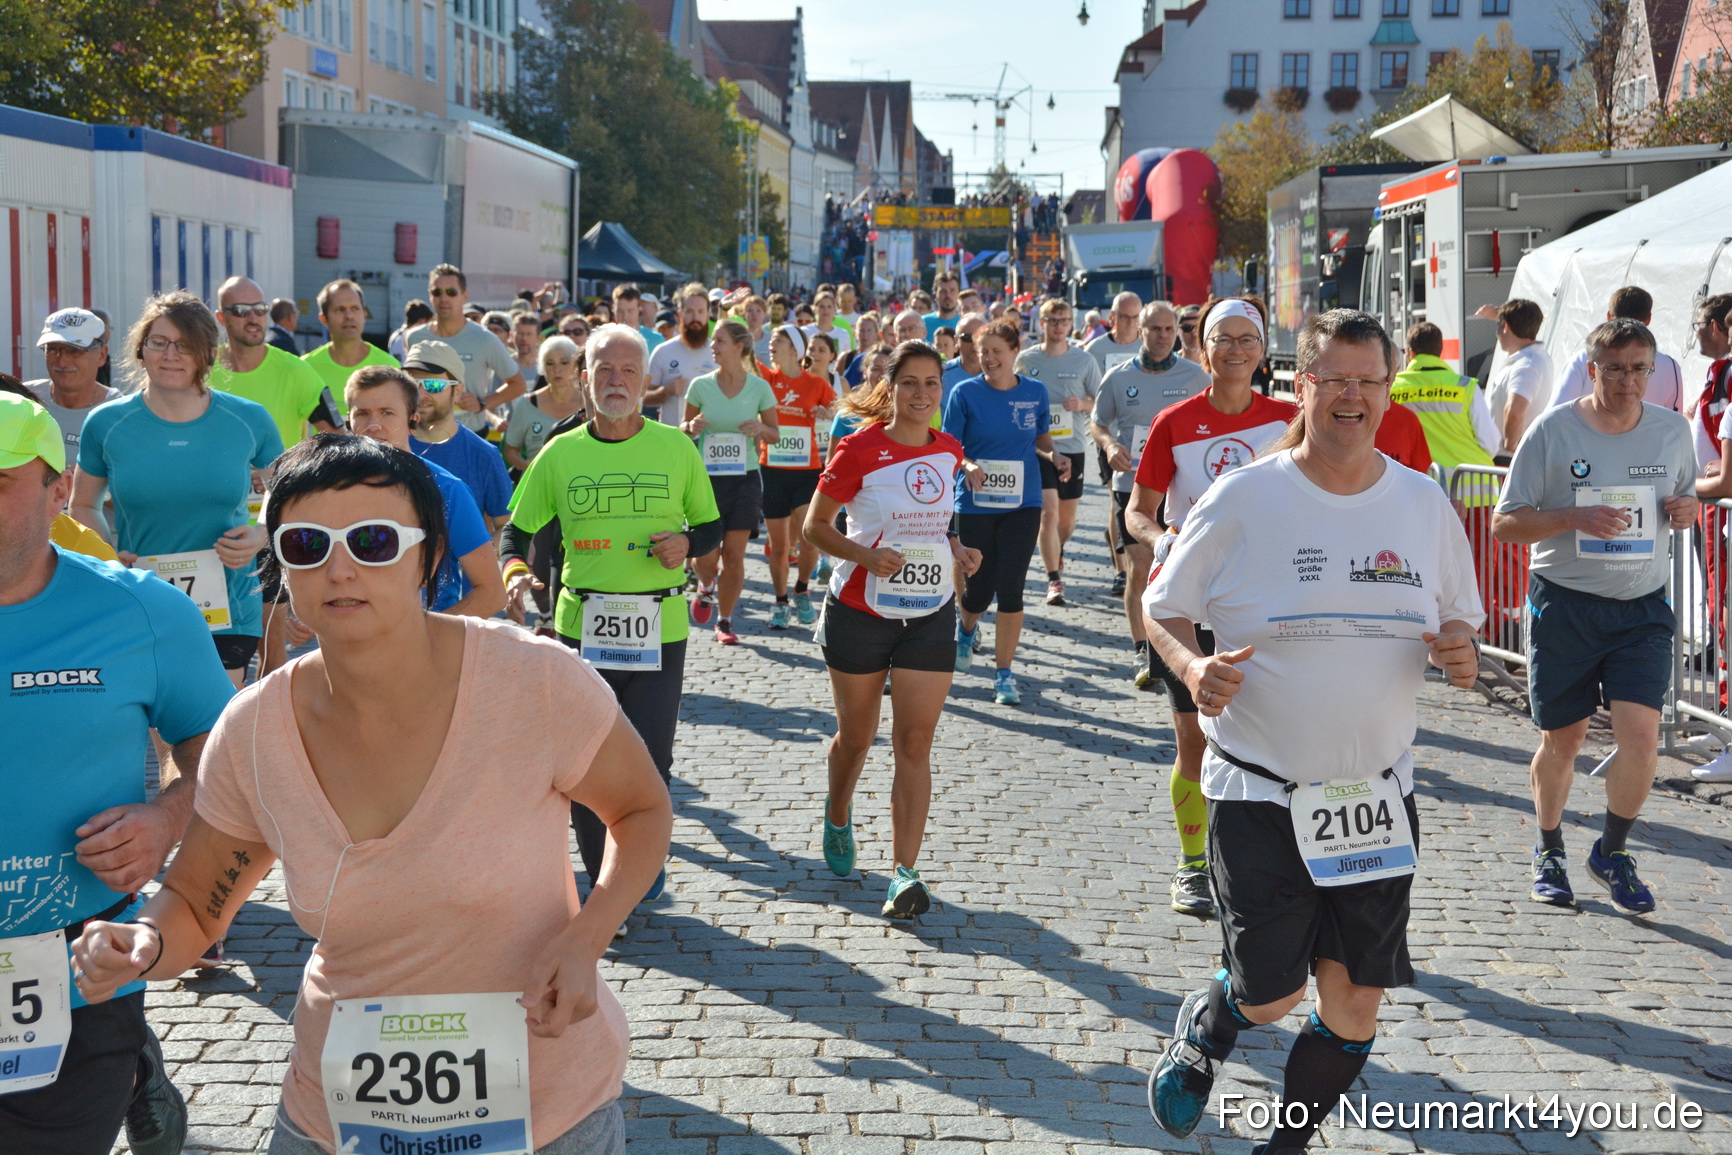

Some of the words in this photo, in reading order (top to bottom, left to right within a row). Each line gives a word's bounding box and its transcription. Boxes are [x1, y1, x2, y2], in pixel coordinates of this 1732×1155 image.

[919, 210, 966, 221] START
[709, 445, 740, 458] 3089
[1628, 465, 1667, 476] BOCK
[981, 473, 1016, 488] 2999
[1601, 493, 1636, 502] BOCK
[892, 511, 923, 520] LAUFEN
[573, 539, 611, 550] MERZ
[1604, 543, 1632, 552] Erwin
[901, 548, 934, 557] BOCK
[1297, 547, 1323, 555] Aktion
[159, 560, 198, 571] BOCK
[1293, 557, 1328, 565] Laufshirt
[1604, 561, 1645, 571] Stadtlauf
[888, 563, 942, 585] 2638
[1298, 566, 1323, 574] Größe
[1299, 574, 1321, 582] XXXL
[604, 601, 639, 610] BOCK
[899, 597, 929, 608] Sevinc
[1395, 608, 1426, 620] Schiller
[594, 614, 649, 639] 2510
[600, 650, 642, 662] Raimund
[11, 668, 105, 690] BOCK
[10, 689, 40, 697] inspired
[53, 686, 75, 694] smart
[76, 686, 107, 694] concepts
[1324, 781, 1372, 798] BOCK
[1312, 799, 1394, 841] 2104
[1323, 842, 1348, 853] PARTL
[1349, 839, 1381, 850] Neumarkt
[1337, 856, 1383, 873] Jürgen
[14, 891, 55, 925] September
[53, 875, 71, 893] 2017
[0, 978, 42, 1026] 5
[380, 1013, 468, 1035] BOCK
[379, 1034, 406, 1042] inspired
[406, 1034, 416, 1042] by
[417, 1033, 437, 1041] smart
[438, 1033, 469, 1041] concepts
[0, 1055, 21, 1075] el
[351, 1048, 488, 1105] 2361
[336, 1092, 344, 1101] D
[371, 1110, 409, 1123] PARTL
[411, 1110, 470, 1124] Neumarkt
[380, 1131, 482, 1155] Christine
